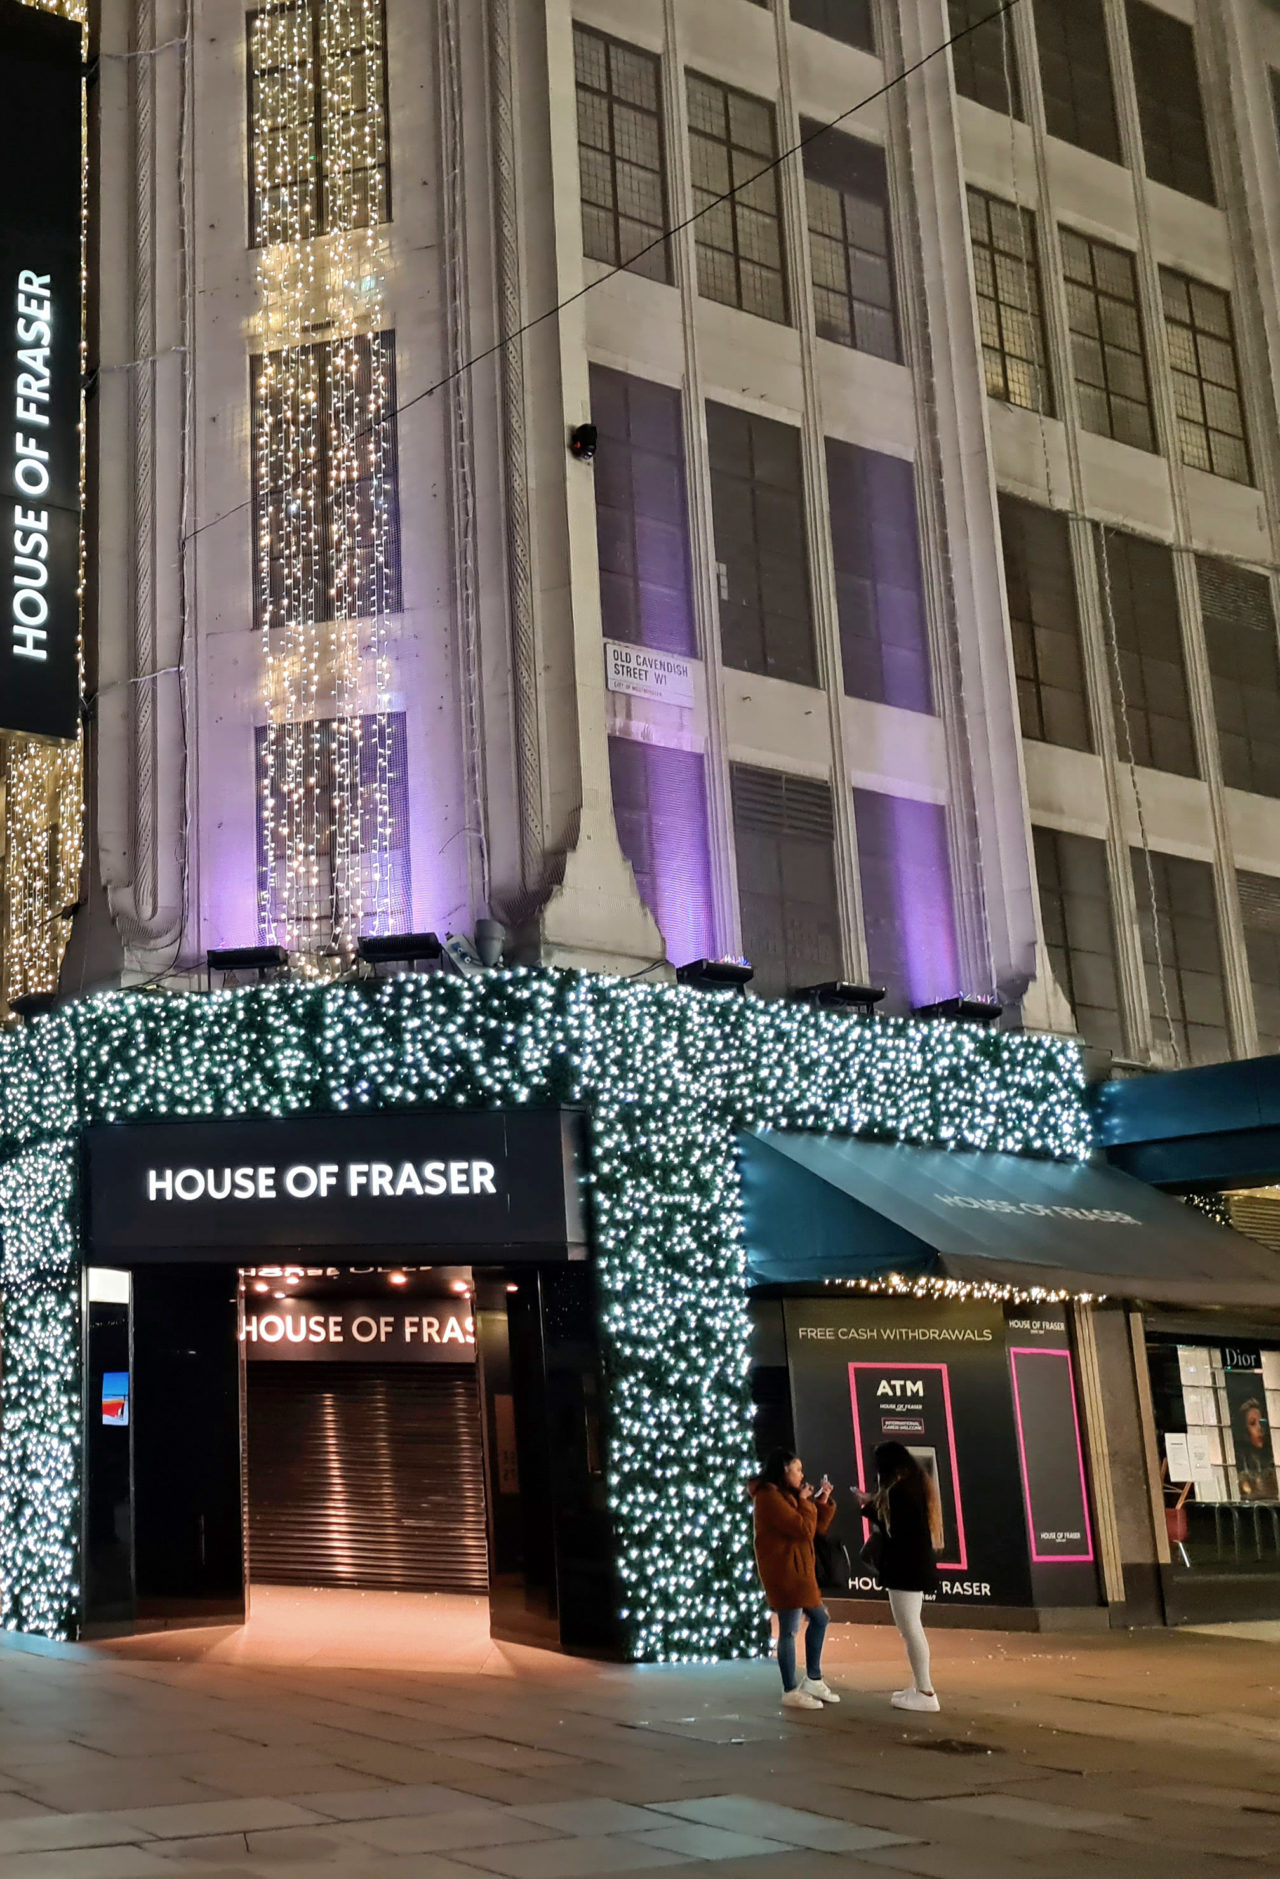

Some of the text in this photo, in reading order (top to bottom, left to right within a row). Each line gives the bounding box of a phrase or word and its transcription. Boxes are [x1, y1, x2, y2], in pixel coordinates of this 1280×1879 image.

[12, 269, 52, 660] HOUSE OF FRASER
[613, 649, 688, 677] OLD CAVENDISH
[614, 663, 667, 685] STREET W1
[148, 1161, 497, 1201] HOUSE OF FRASER
[934, 1192, 1143, 1226] HOUSE OF FRASER
[238, 1315, 476, 1343] HOUSE OF FRAS
[798, 1327, 993, 1341] FREE CASH WITHDRAWALS
[1009, 1319, 1065, 1331] HOUSE OF FRASER
[1225, 1347, 1257, 1367] Dior
[876, 1379, 924, 1397] ATM
[848, 1576, 991, 1596] HOU RASER
